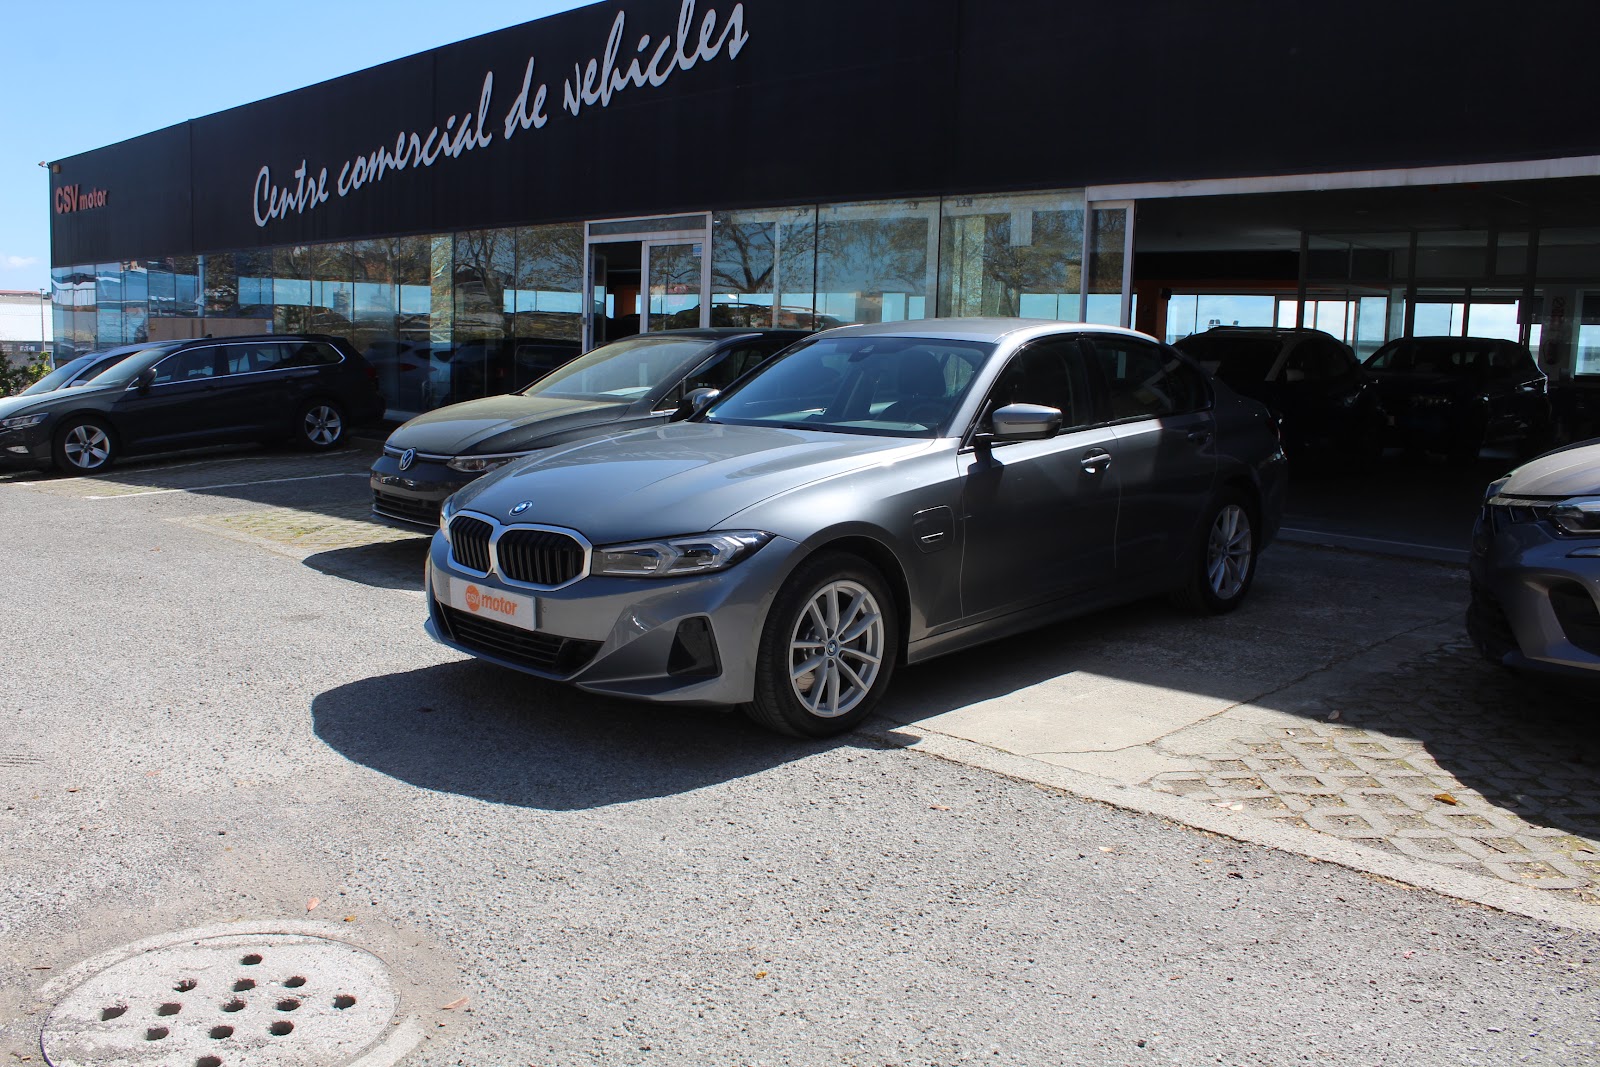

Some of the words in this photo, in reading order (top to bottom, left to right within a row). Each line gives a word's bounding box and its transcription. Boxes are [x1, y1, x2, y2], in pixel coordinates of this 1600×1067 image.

[253, 159, 329, 227] Centre
[337, 71, 492, 197] comercial
[504, 56, 548, 140] de
[563, 0, 749, 117] vehicles
[55, 183, 79, 214] CSV
[80, 187, 107, 211] motor
[481, 594, 518, 616] motor
